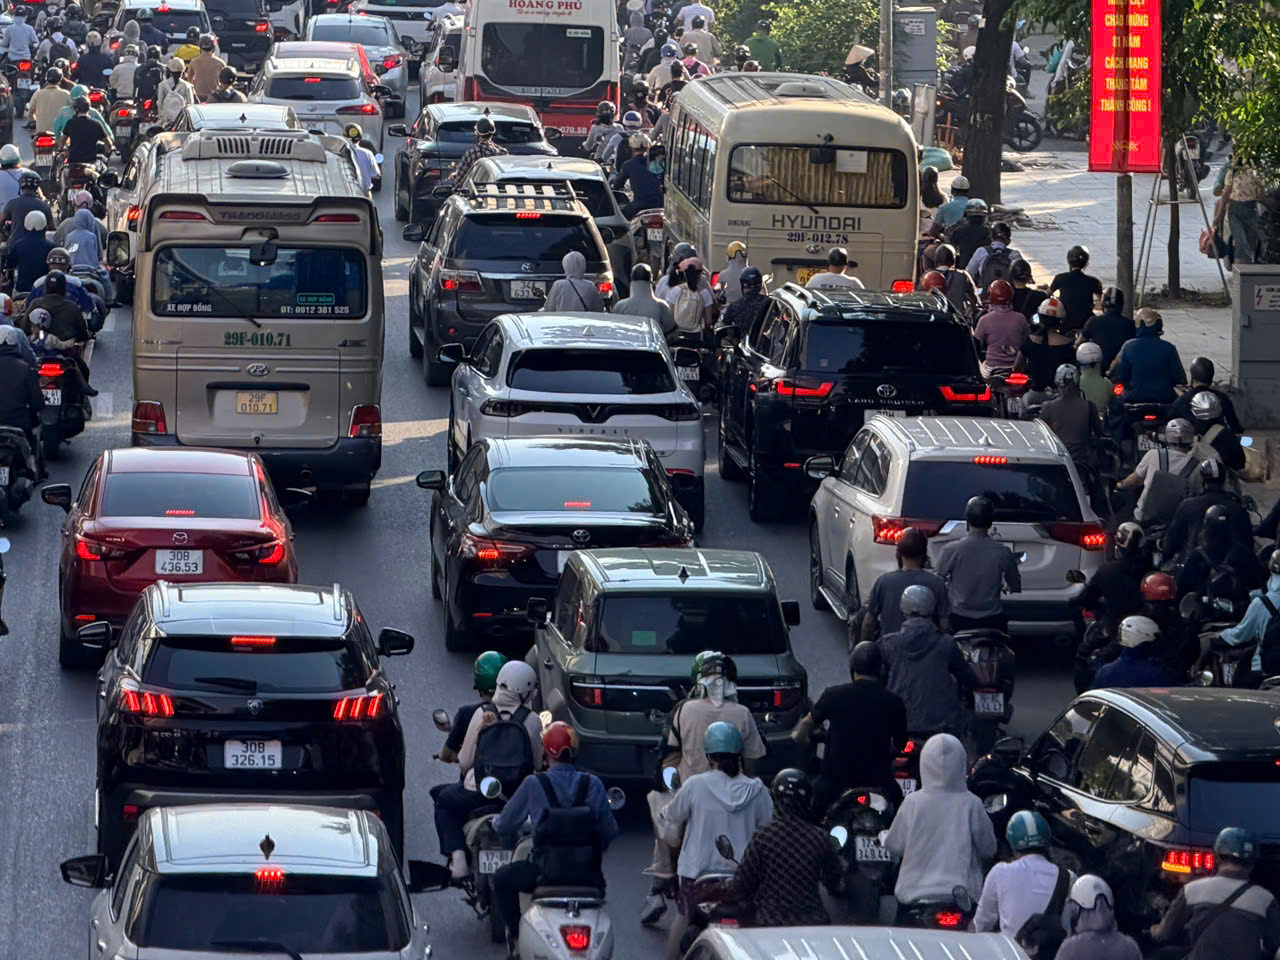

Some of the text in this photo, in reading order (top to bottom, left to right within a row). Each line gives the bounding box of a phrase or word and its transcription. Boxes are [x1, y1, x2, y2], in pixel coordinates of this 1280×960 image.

[1105, 54, 1123, 68] CÁCH
[1130, 76, 1147, 90] TÁM
[772, 214, 861, 230] HYUNDAI
[177, 304, 191, 312] HỢP
[192, 302, 212, 312] ĐỒNG
[334, 306, 350, 314] 525
[224, 331, 291, 346] 29F-010.71
[249, 393, 266, 402] 29F
[241, 403, 273, 412] 010.71
[169, 551, 190, 561] 30B
[161, 562, 199, 572] 436.53
[242, 742, 265, 753] 30B
[232, 755, 276, 766] 326.15
